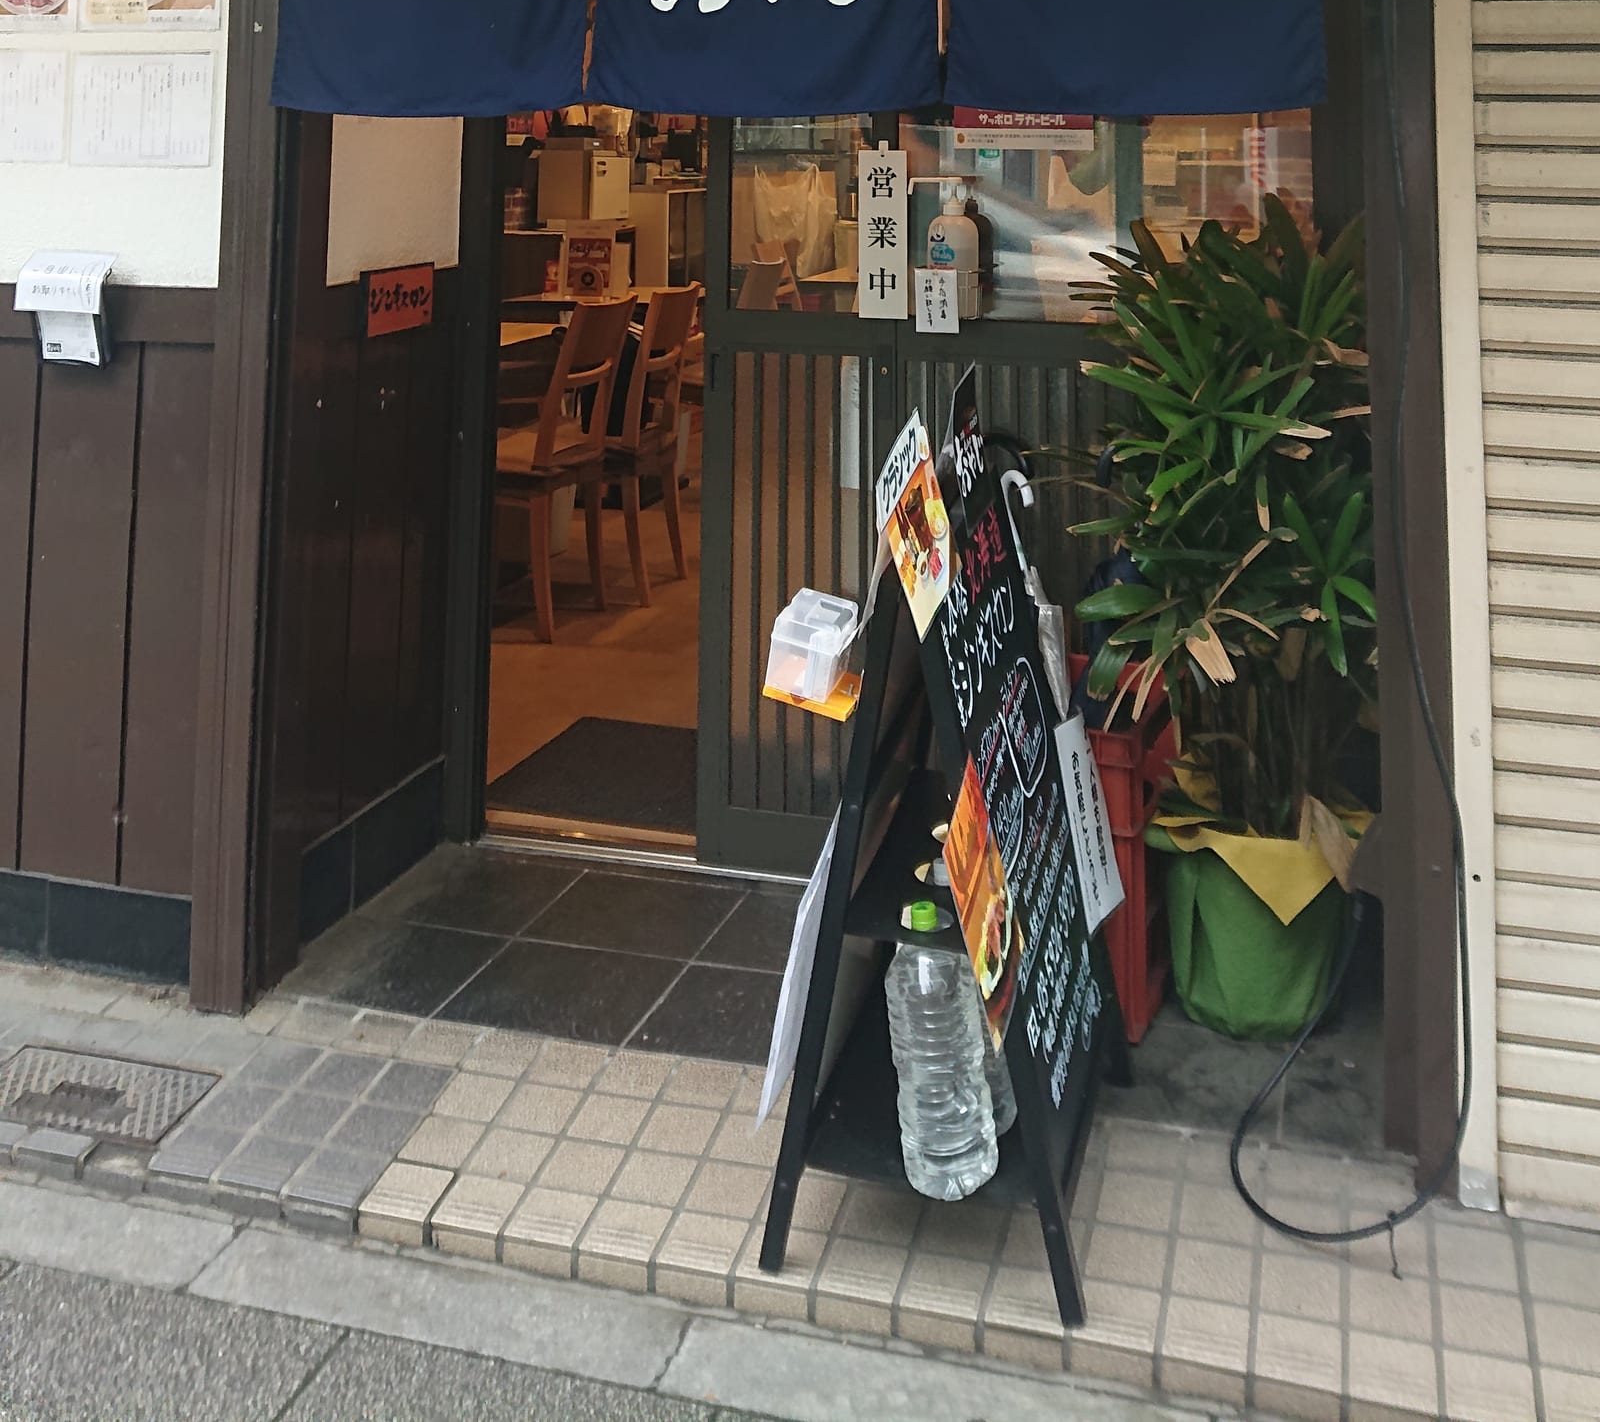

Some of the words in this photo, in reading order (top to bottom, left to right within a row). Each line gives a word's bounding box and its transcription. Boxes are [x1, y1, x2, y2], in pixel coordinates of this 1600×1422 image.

[978, 113, 1013, 126] サッポロ
[1014, 114, 1066, 127] ラガービール
[866, 165, 898, 301] 営業中
[879, 424, 918, 515] クラシック
[956, 577, 1014, 720] ジンギスカン
